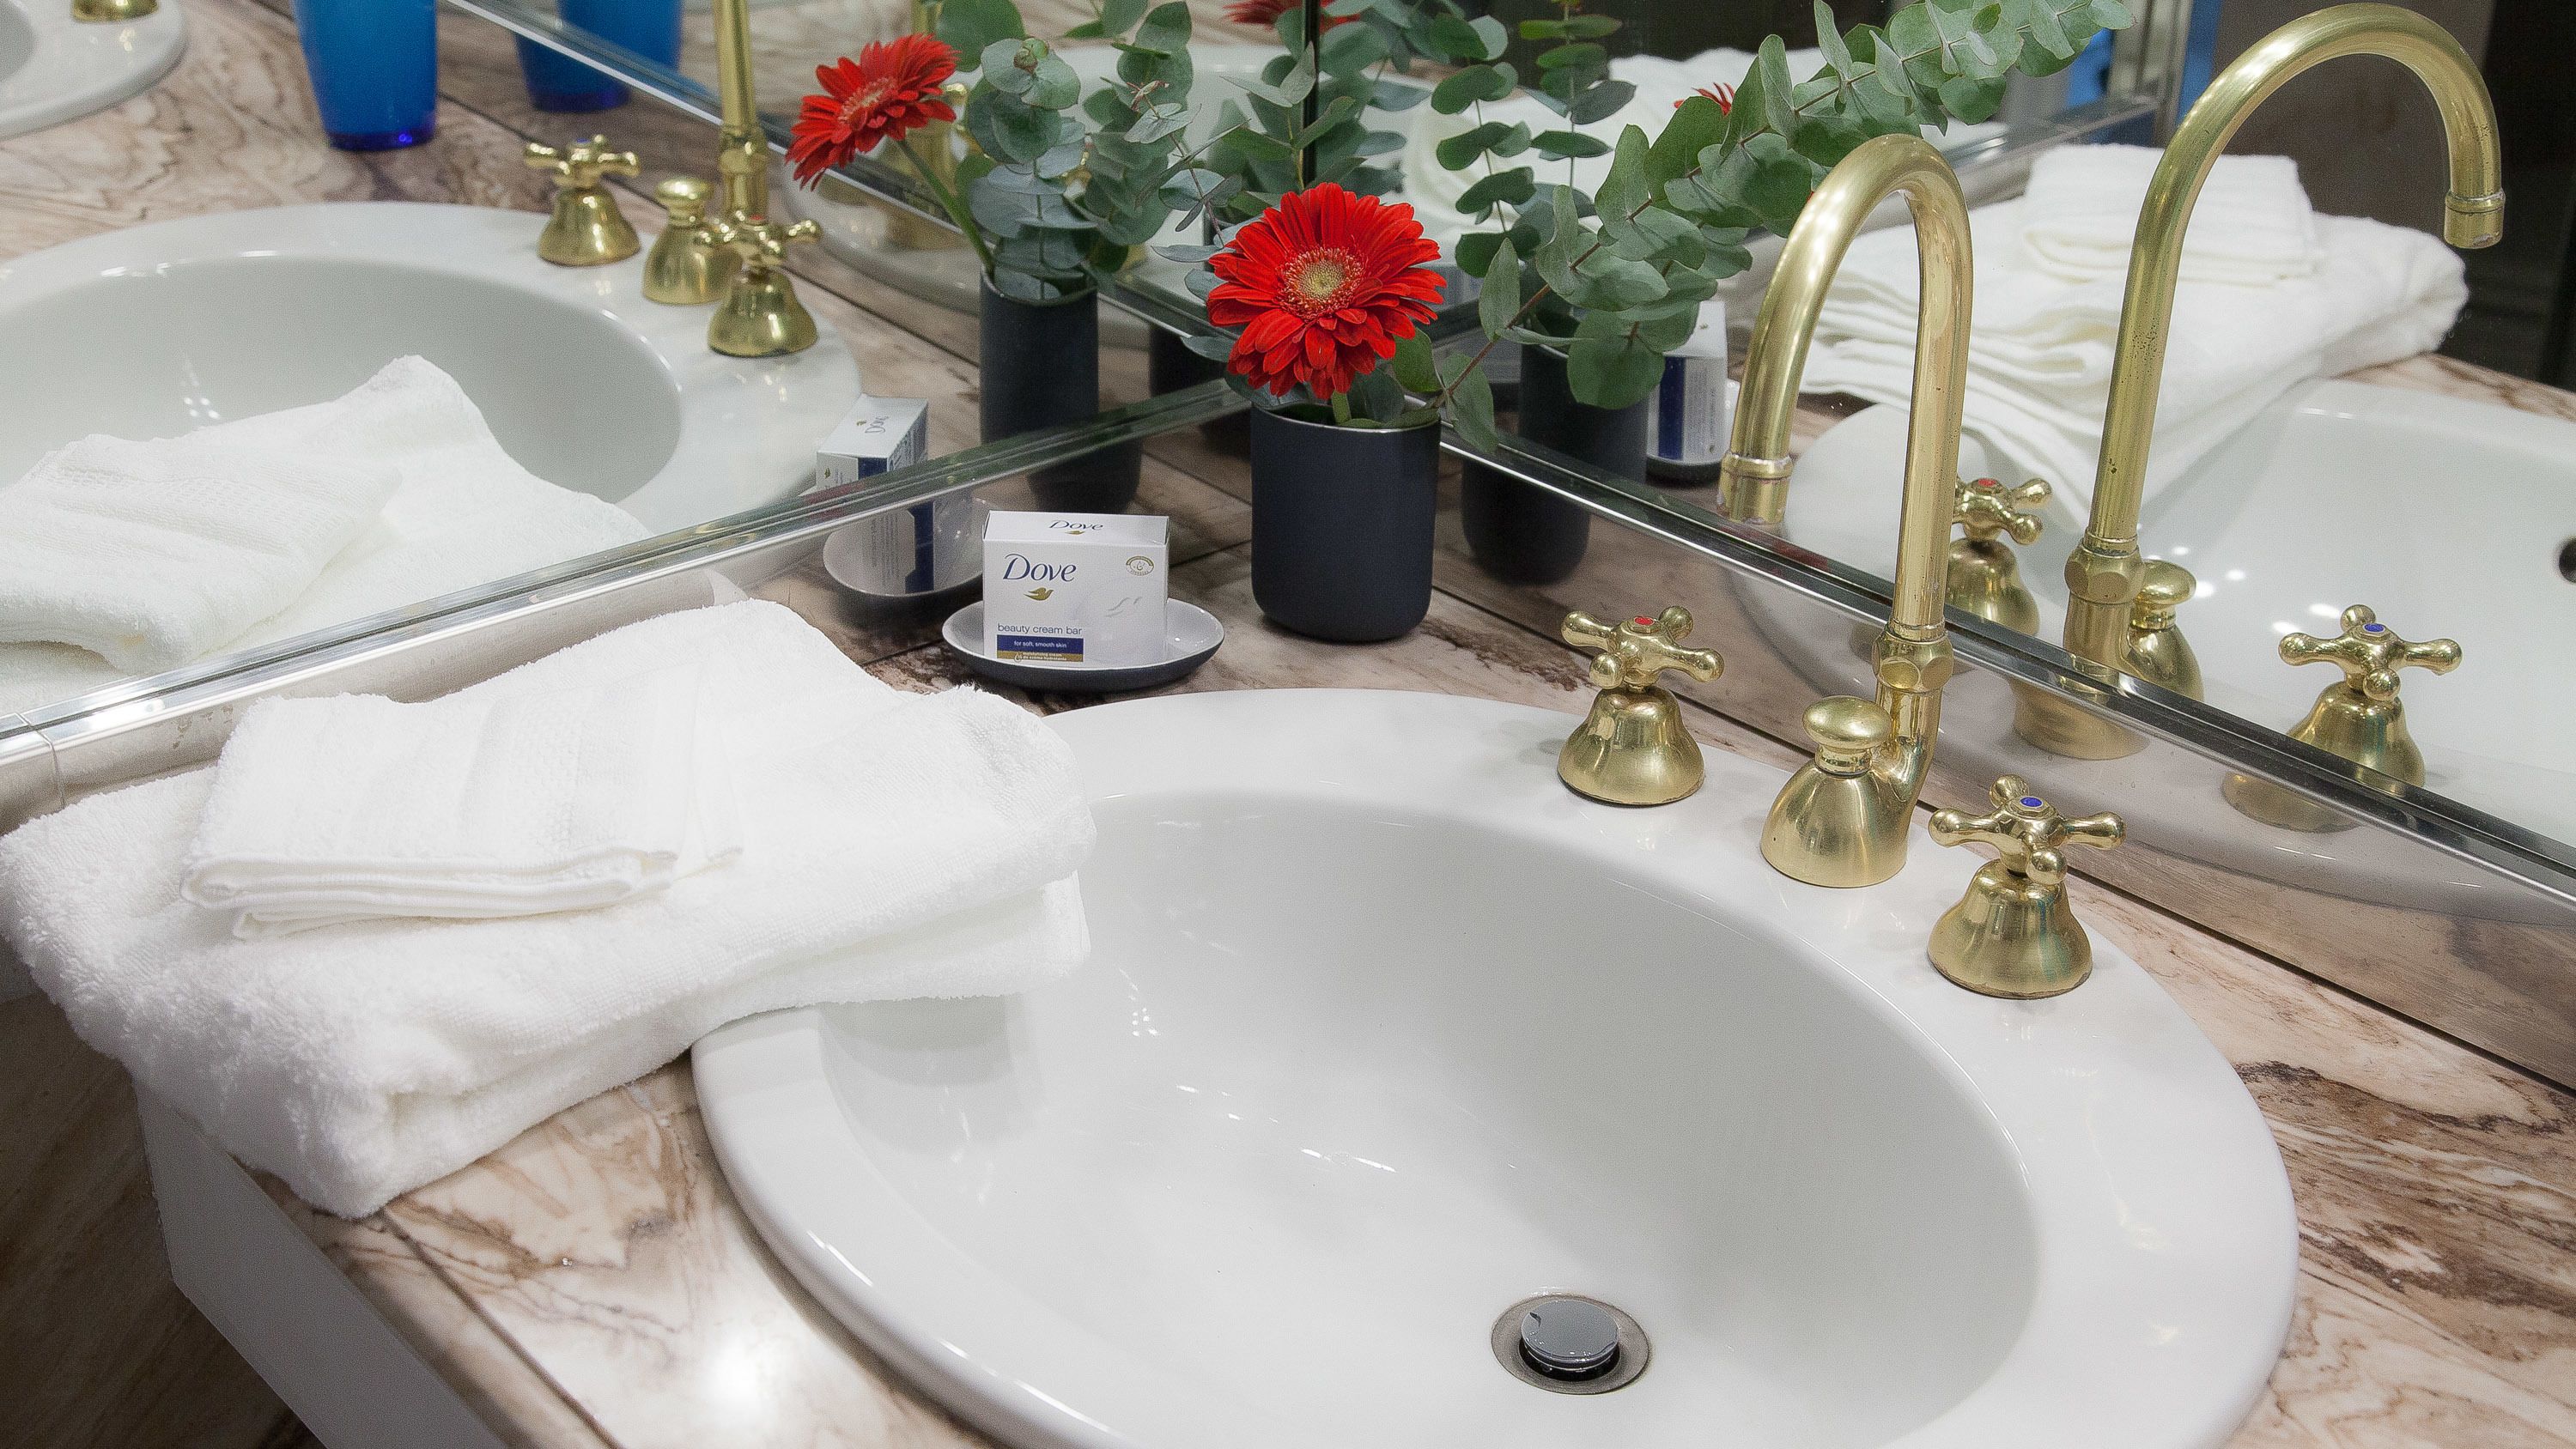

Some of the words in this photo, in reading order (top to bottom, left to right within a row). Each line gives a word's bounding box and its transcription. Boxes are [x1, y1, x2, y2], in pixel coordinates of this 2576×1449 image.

[1048, 519, 1103, 530] Dove
[1002, 553, 1077, 582] Dove
[998, 623, 1030, 634] beauty
[1066, 626, 1083, 634] bar
